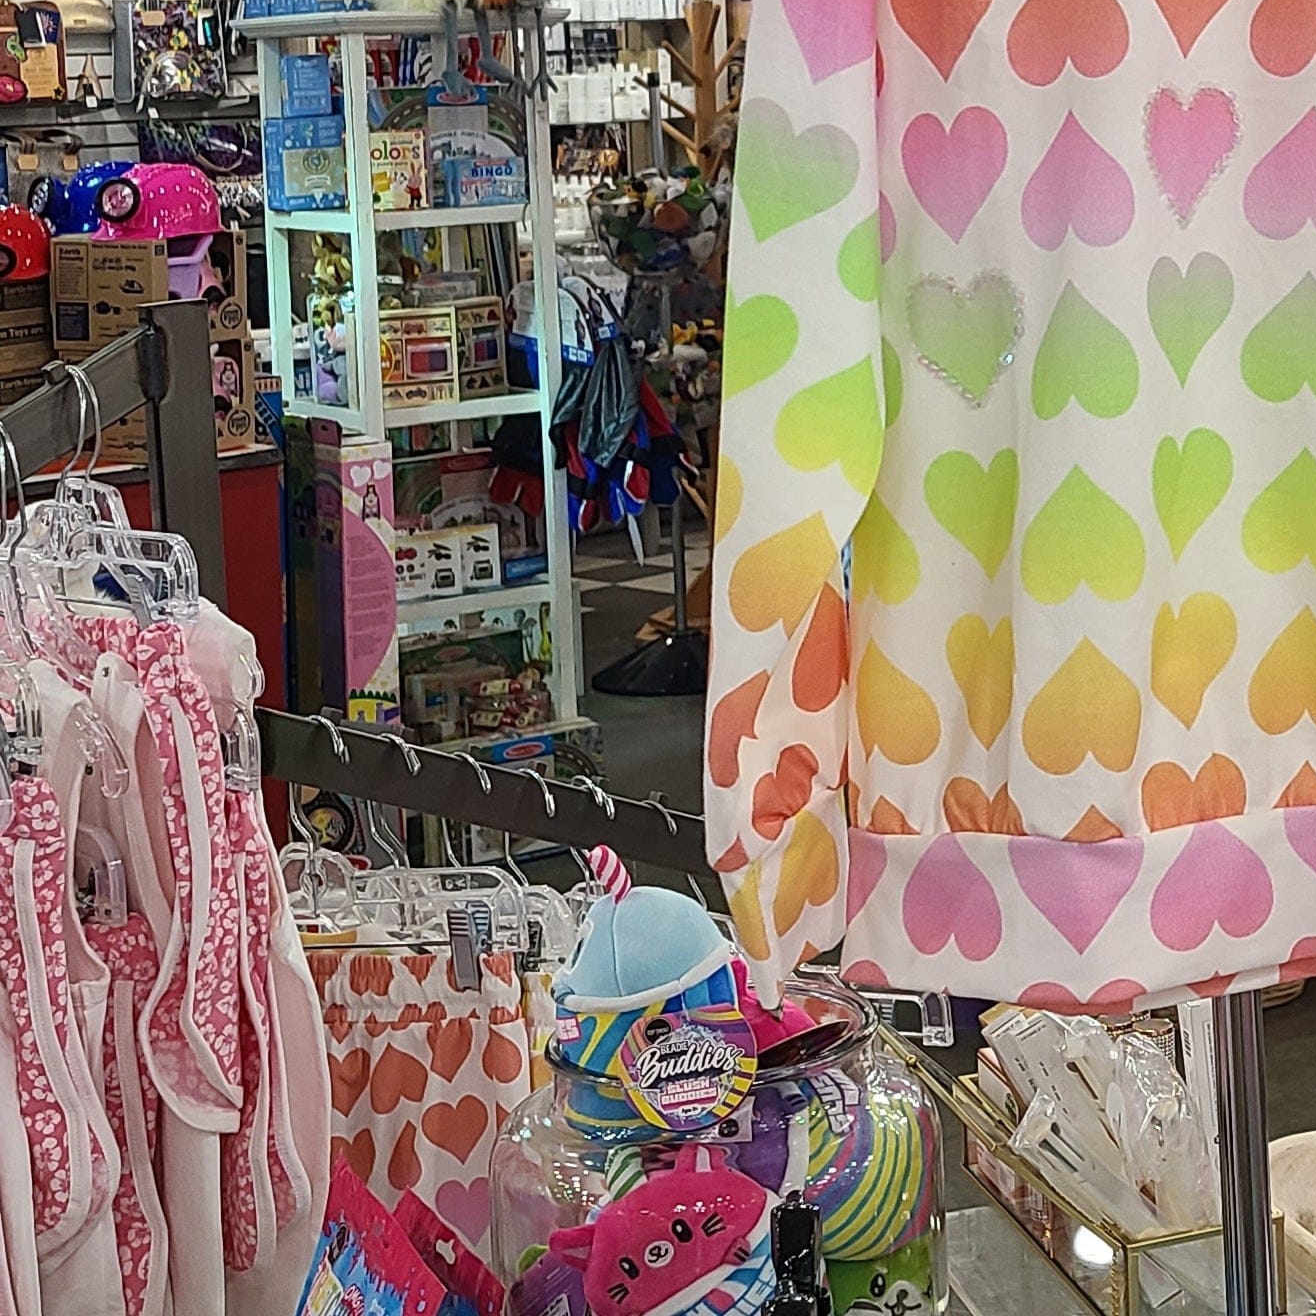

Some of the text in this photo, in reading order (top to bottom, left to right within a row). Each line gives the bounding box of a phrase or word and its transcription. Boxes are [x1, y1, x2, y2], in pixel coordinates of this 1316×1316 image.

[369, 140, 421, 161] olors
[471, 166, 513, 179] BINGO
[660, 1041, 690, 1055] BEADIE
[636, 1040, 744, 1090] Buddies
